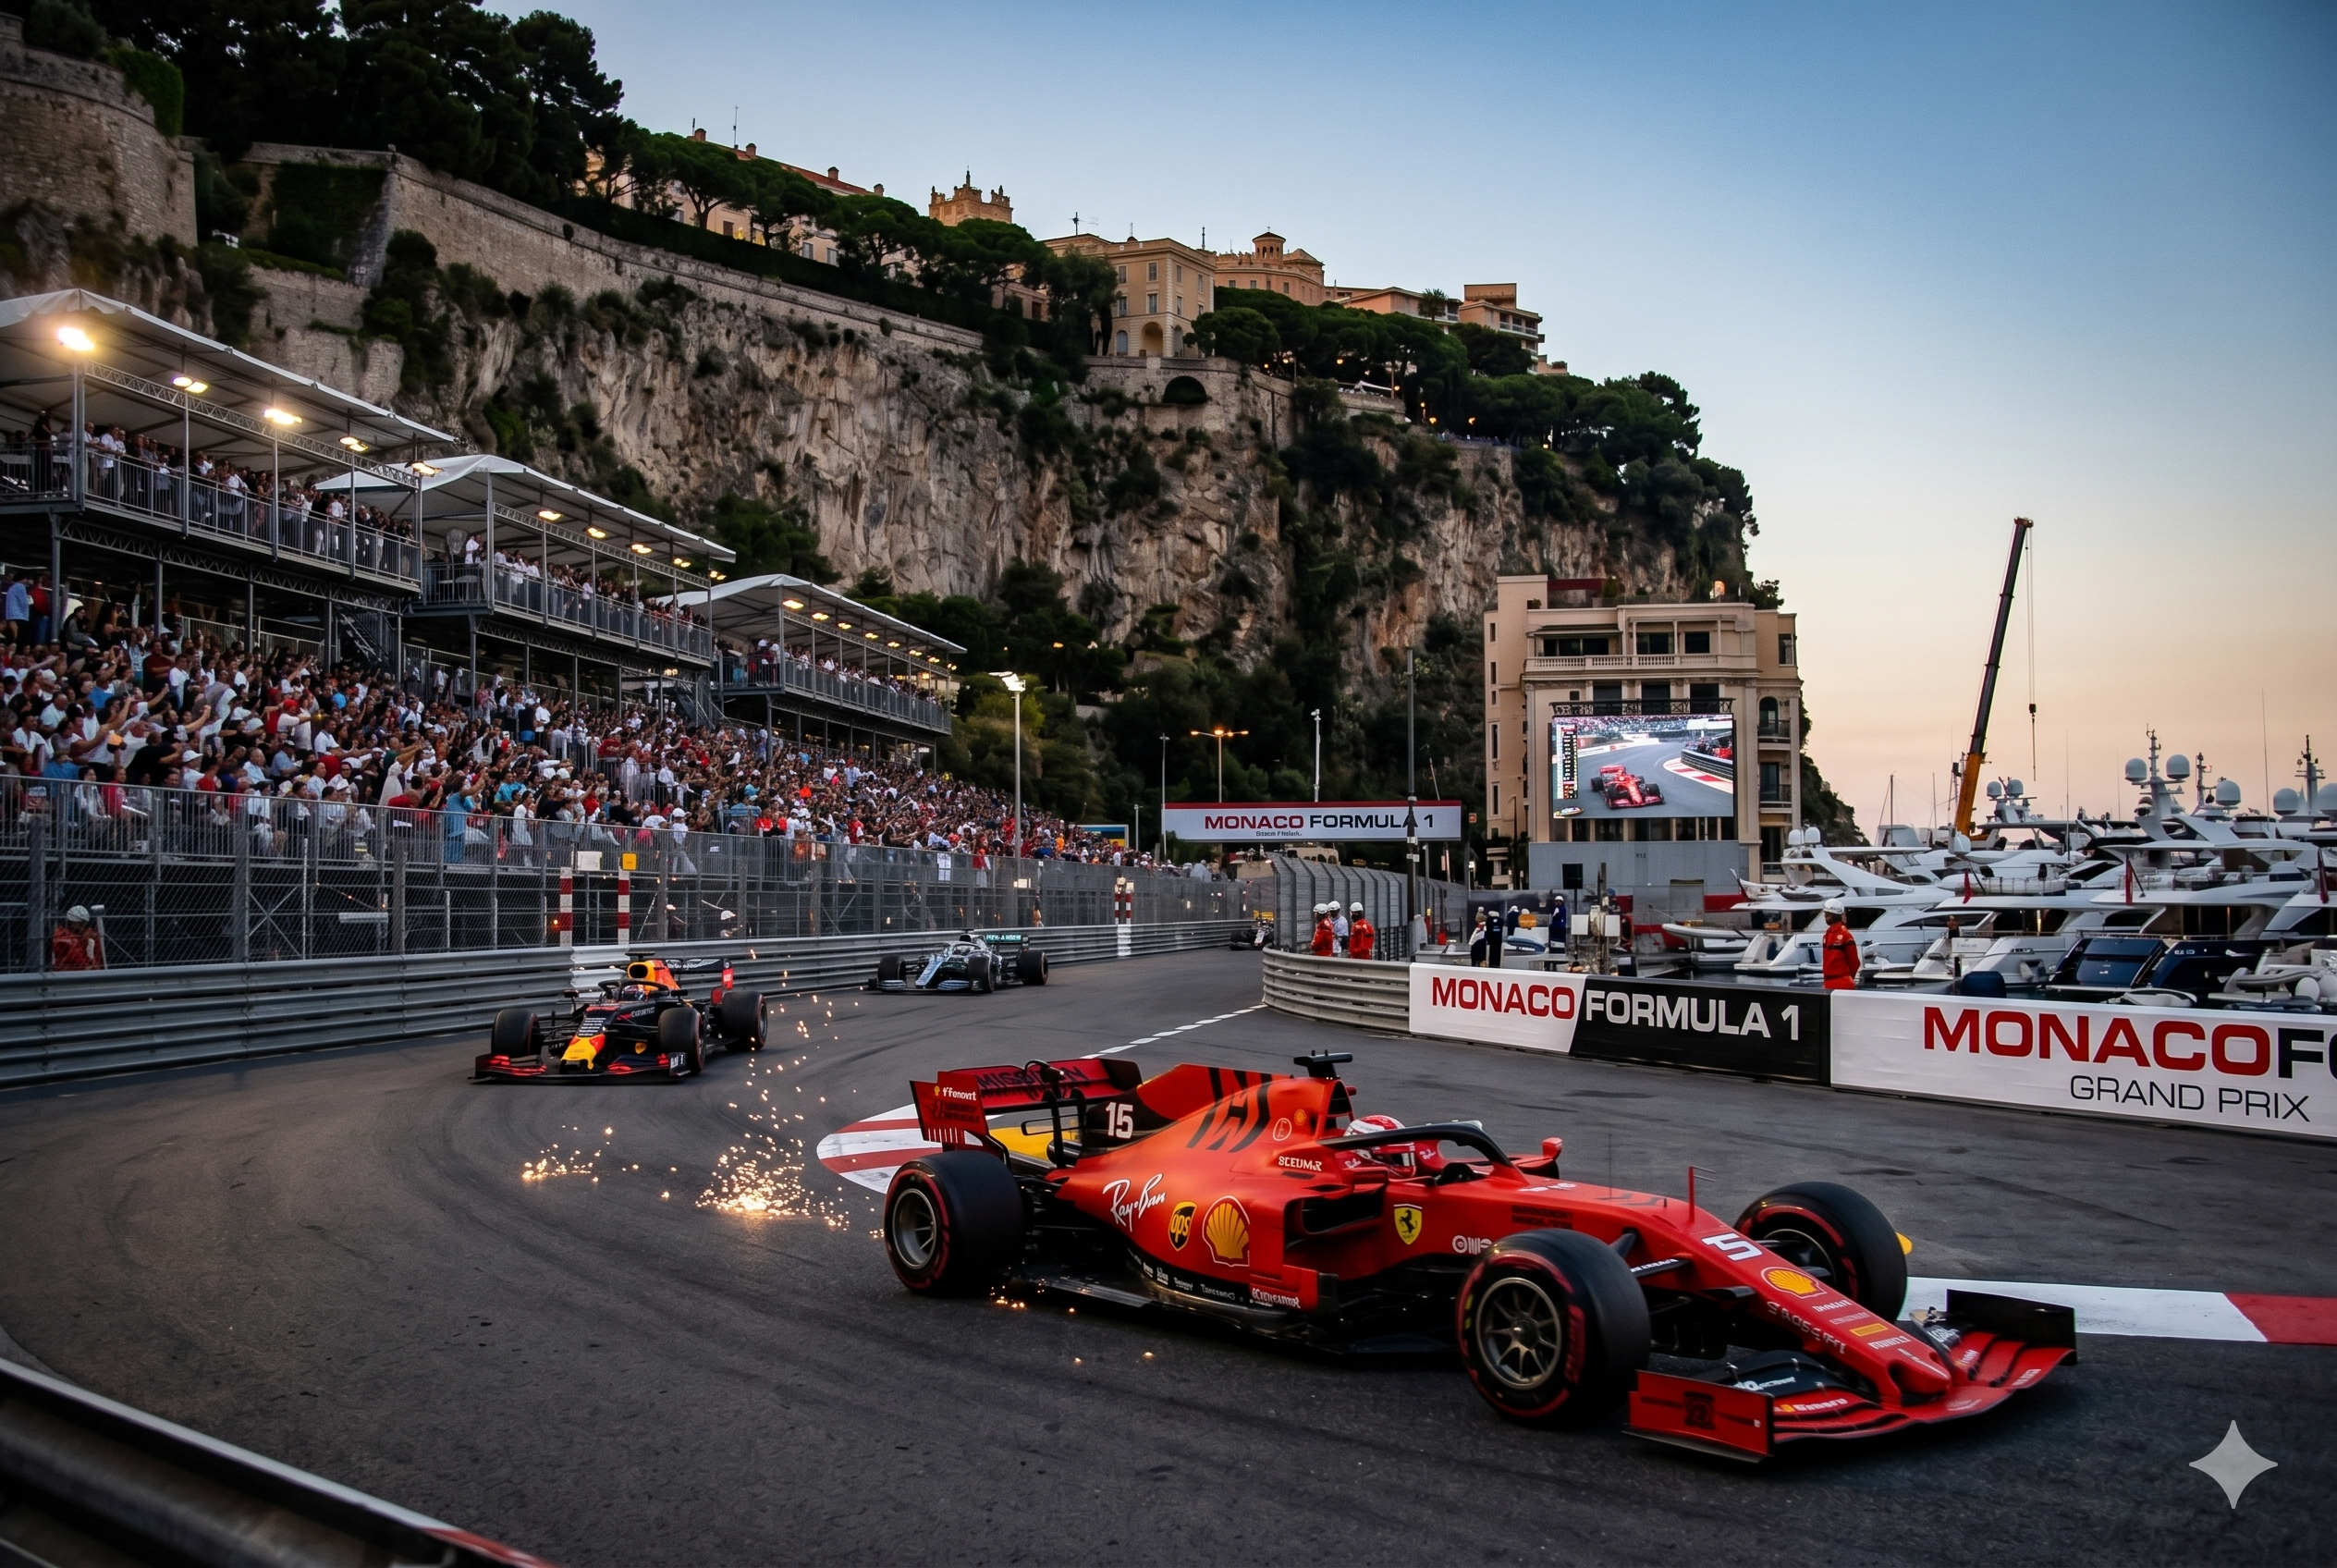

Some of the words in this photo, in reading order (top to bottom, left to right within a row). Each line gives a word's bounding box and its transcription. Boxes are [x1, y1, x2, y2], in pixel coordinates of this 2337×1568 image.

[1205, 815, 1304, 829] MONACO
[1424, 815, 1434, 828] 1
[1432, 976, 1575, 1020] MONACO
[1585, 989, 1771, 1038] FORMULA
[1780, 1005, 1799, 1041] 1
[2070, 1074, 2206, 1110] GRAND
[2219, 1087, 2311, 1122] PRIX
[1106, 1101, 1134, 1139] 15
[1702, 1232, 1763, 1261] 5
